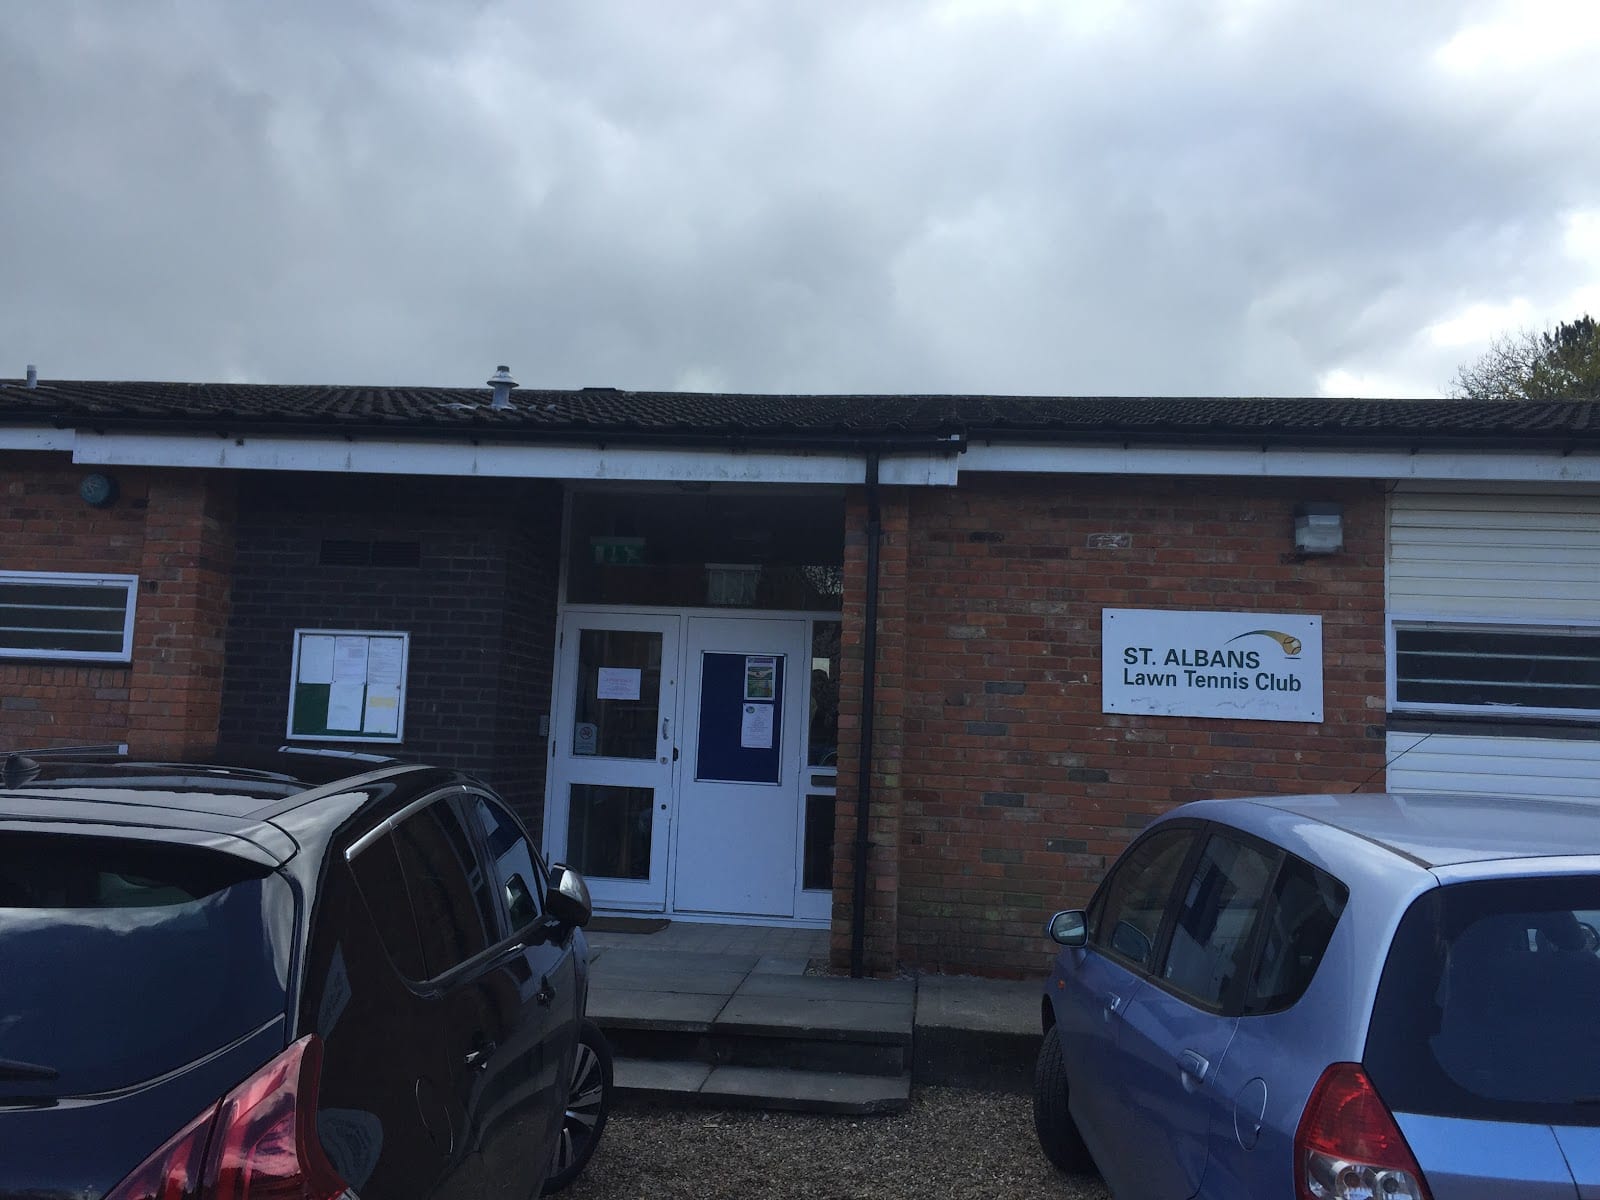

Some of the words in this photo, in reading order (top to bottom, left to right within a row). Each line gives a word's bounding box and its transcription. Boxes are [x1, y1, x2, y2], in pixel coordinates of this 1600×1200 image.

[1123, 647, 1156, 666] ST.
[1164, 648, 1261, 669] ALBANS
[1123, 668, 1177, 687] Lawn
[1184, 670, 1249, 690] Tennis
[1255, 672, 1302, 692] Club
